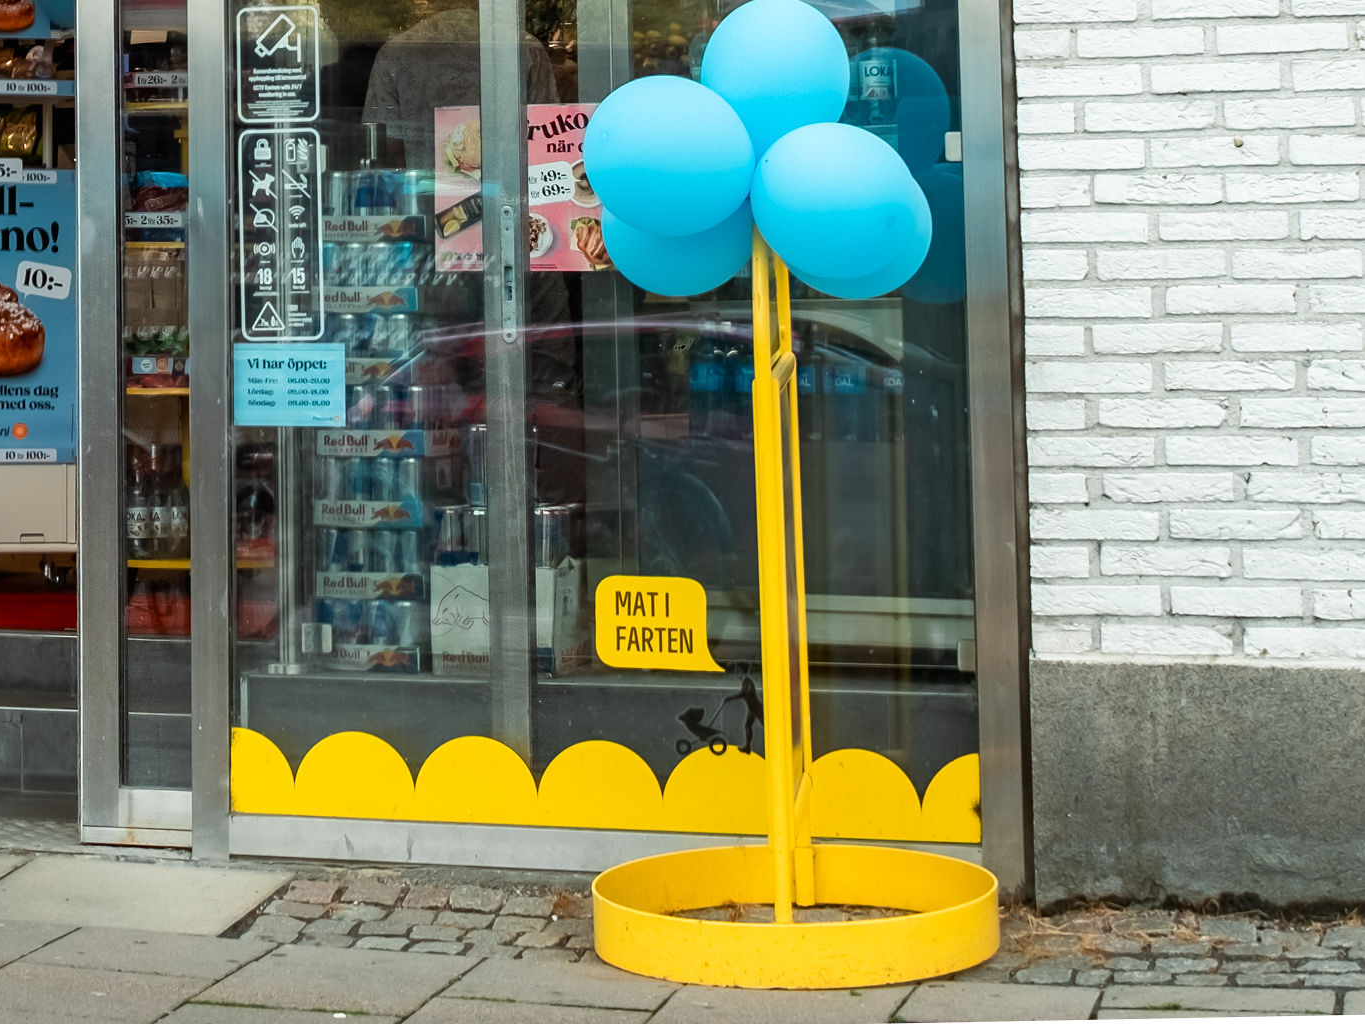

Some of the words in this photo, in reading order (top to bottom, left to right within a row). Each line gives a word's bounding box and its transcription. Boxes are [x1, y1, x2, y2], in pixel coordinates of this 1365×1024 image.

[864, 65, 891, 77] LOKA
[148, 75, 167, 85] 26:-
[172, 75, 178, 84] 2
[528, 113, 589, 141] ruko
[546, 140, 574, 153] när
[542, 184, 571, 197] 69:-
[141, 215, 148, 225] 2
[156, 215, 179, 225] 35:-
[348, 220, 368, 232] Bull
[23, 267, 63, 291] 10:-
[257, 268, 273, 285] 18
[290, 268, 306, 284] 15
[247, 358, 259, 369] Vi
[263, 359, 284, 369] har
[287, 358, 327, 371] öppet:
[33, 385, 59, 398] dag
[0, 399, 26, 410] med
[29, 401, 55, 410] oss.
[347, 435, 368, 446] Bull
[6, 452, 16, 460] 10
[26, 452, 50, 460] 100:-
[345, 504, 366, 515] Bull
[615, 590, 658, 617] MAT
[665, 592, 670, 618] I
[616, 626, 694, 654] FARTEN
